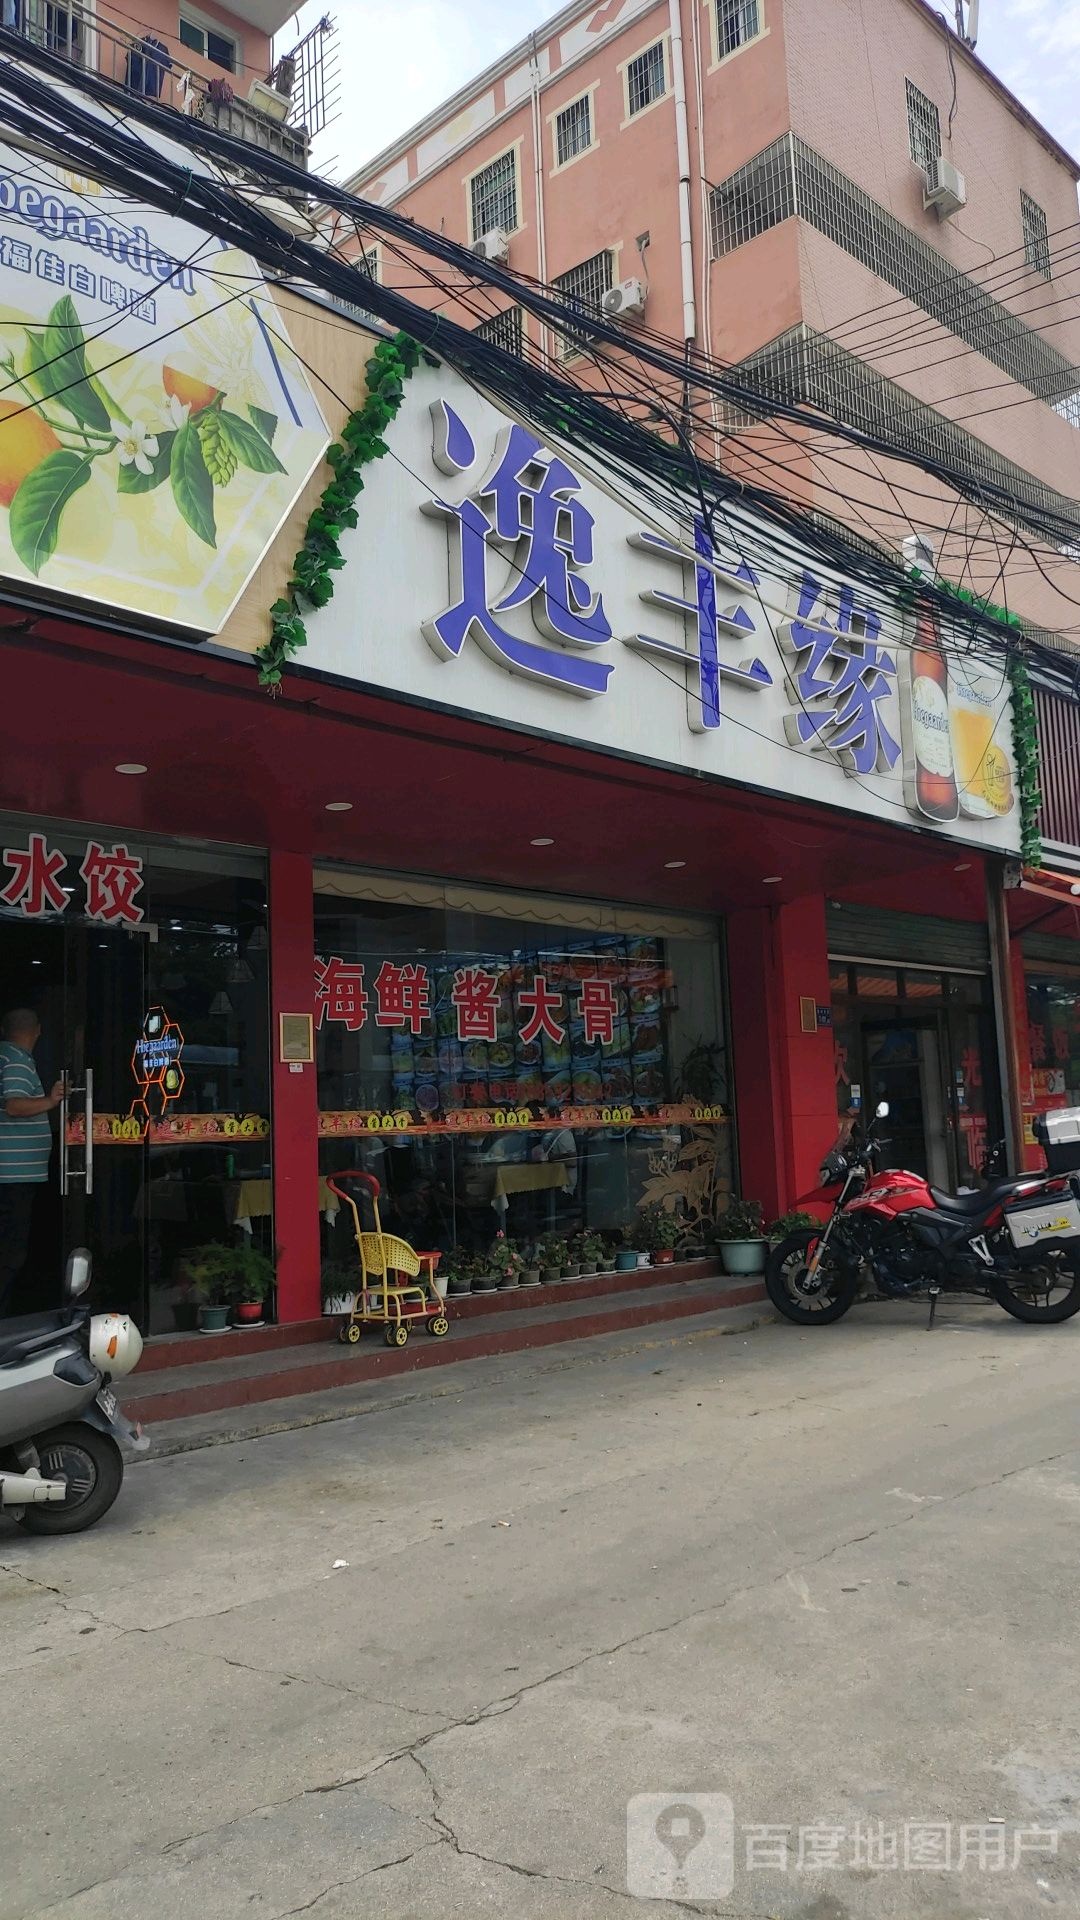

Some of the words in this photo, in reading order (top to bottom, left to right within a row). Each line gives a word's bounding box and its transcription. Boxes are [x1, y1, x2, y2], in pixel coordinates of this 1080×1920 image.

[0, 235, 157, 326] 福佳白啤酒
[419, 397, 903, 779] 逸丰缘
[0, 832, 145, 925] 水饺
[314, 956, 619, 1046] 海鲜酱大骨
